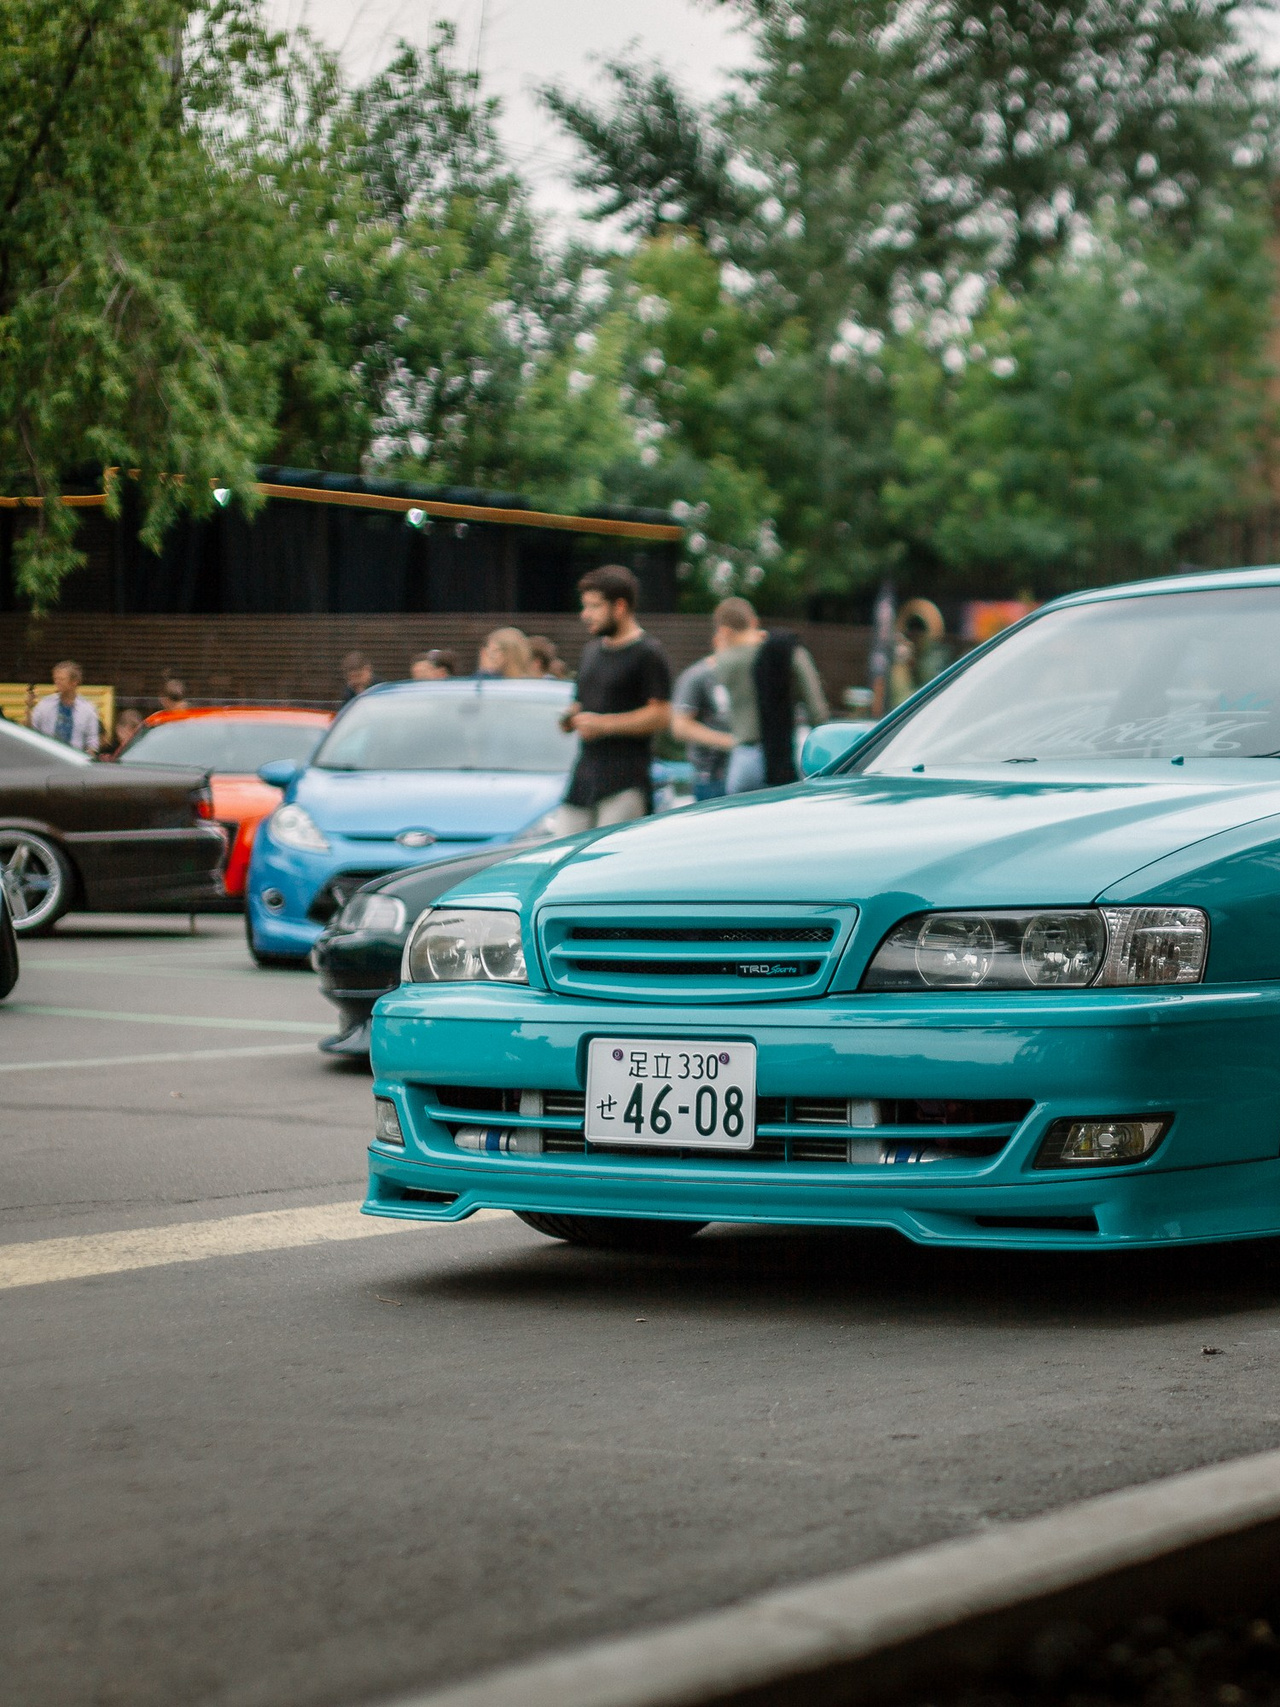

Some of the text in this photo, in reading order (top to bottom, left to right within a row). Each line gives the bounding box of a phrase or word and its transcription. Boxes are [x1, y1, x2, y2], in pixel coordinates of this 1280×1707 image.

[740, 965, 769, 973] TRD
[629, 1051, 718, 1080] 足立 330
[596, 1082, 744, 1138] せ 46-08
